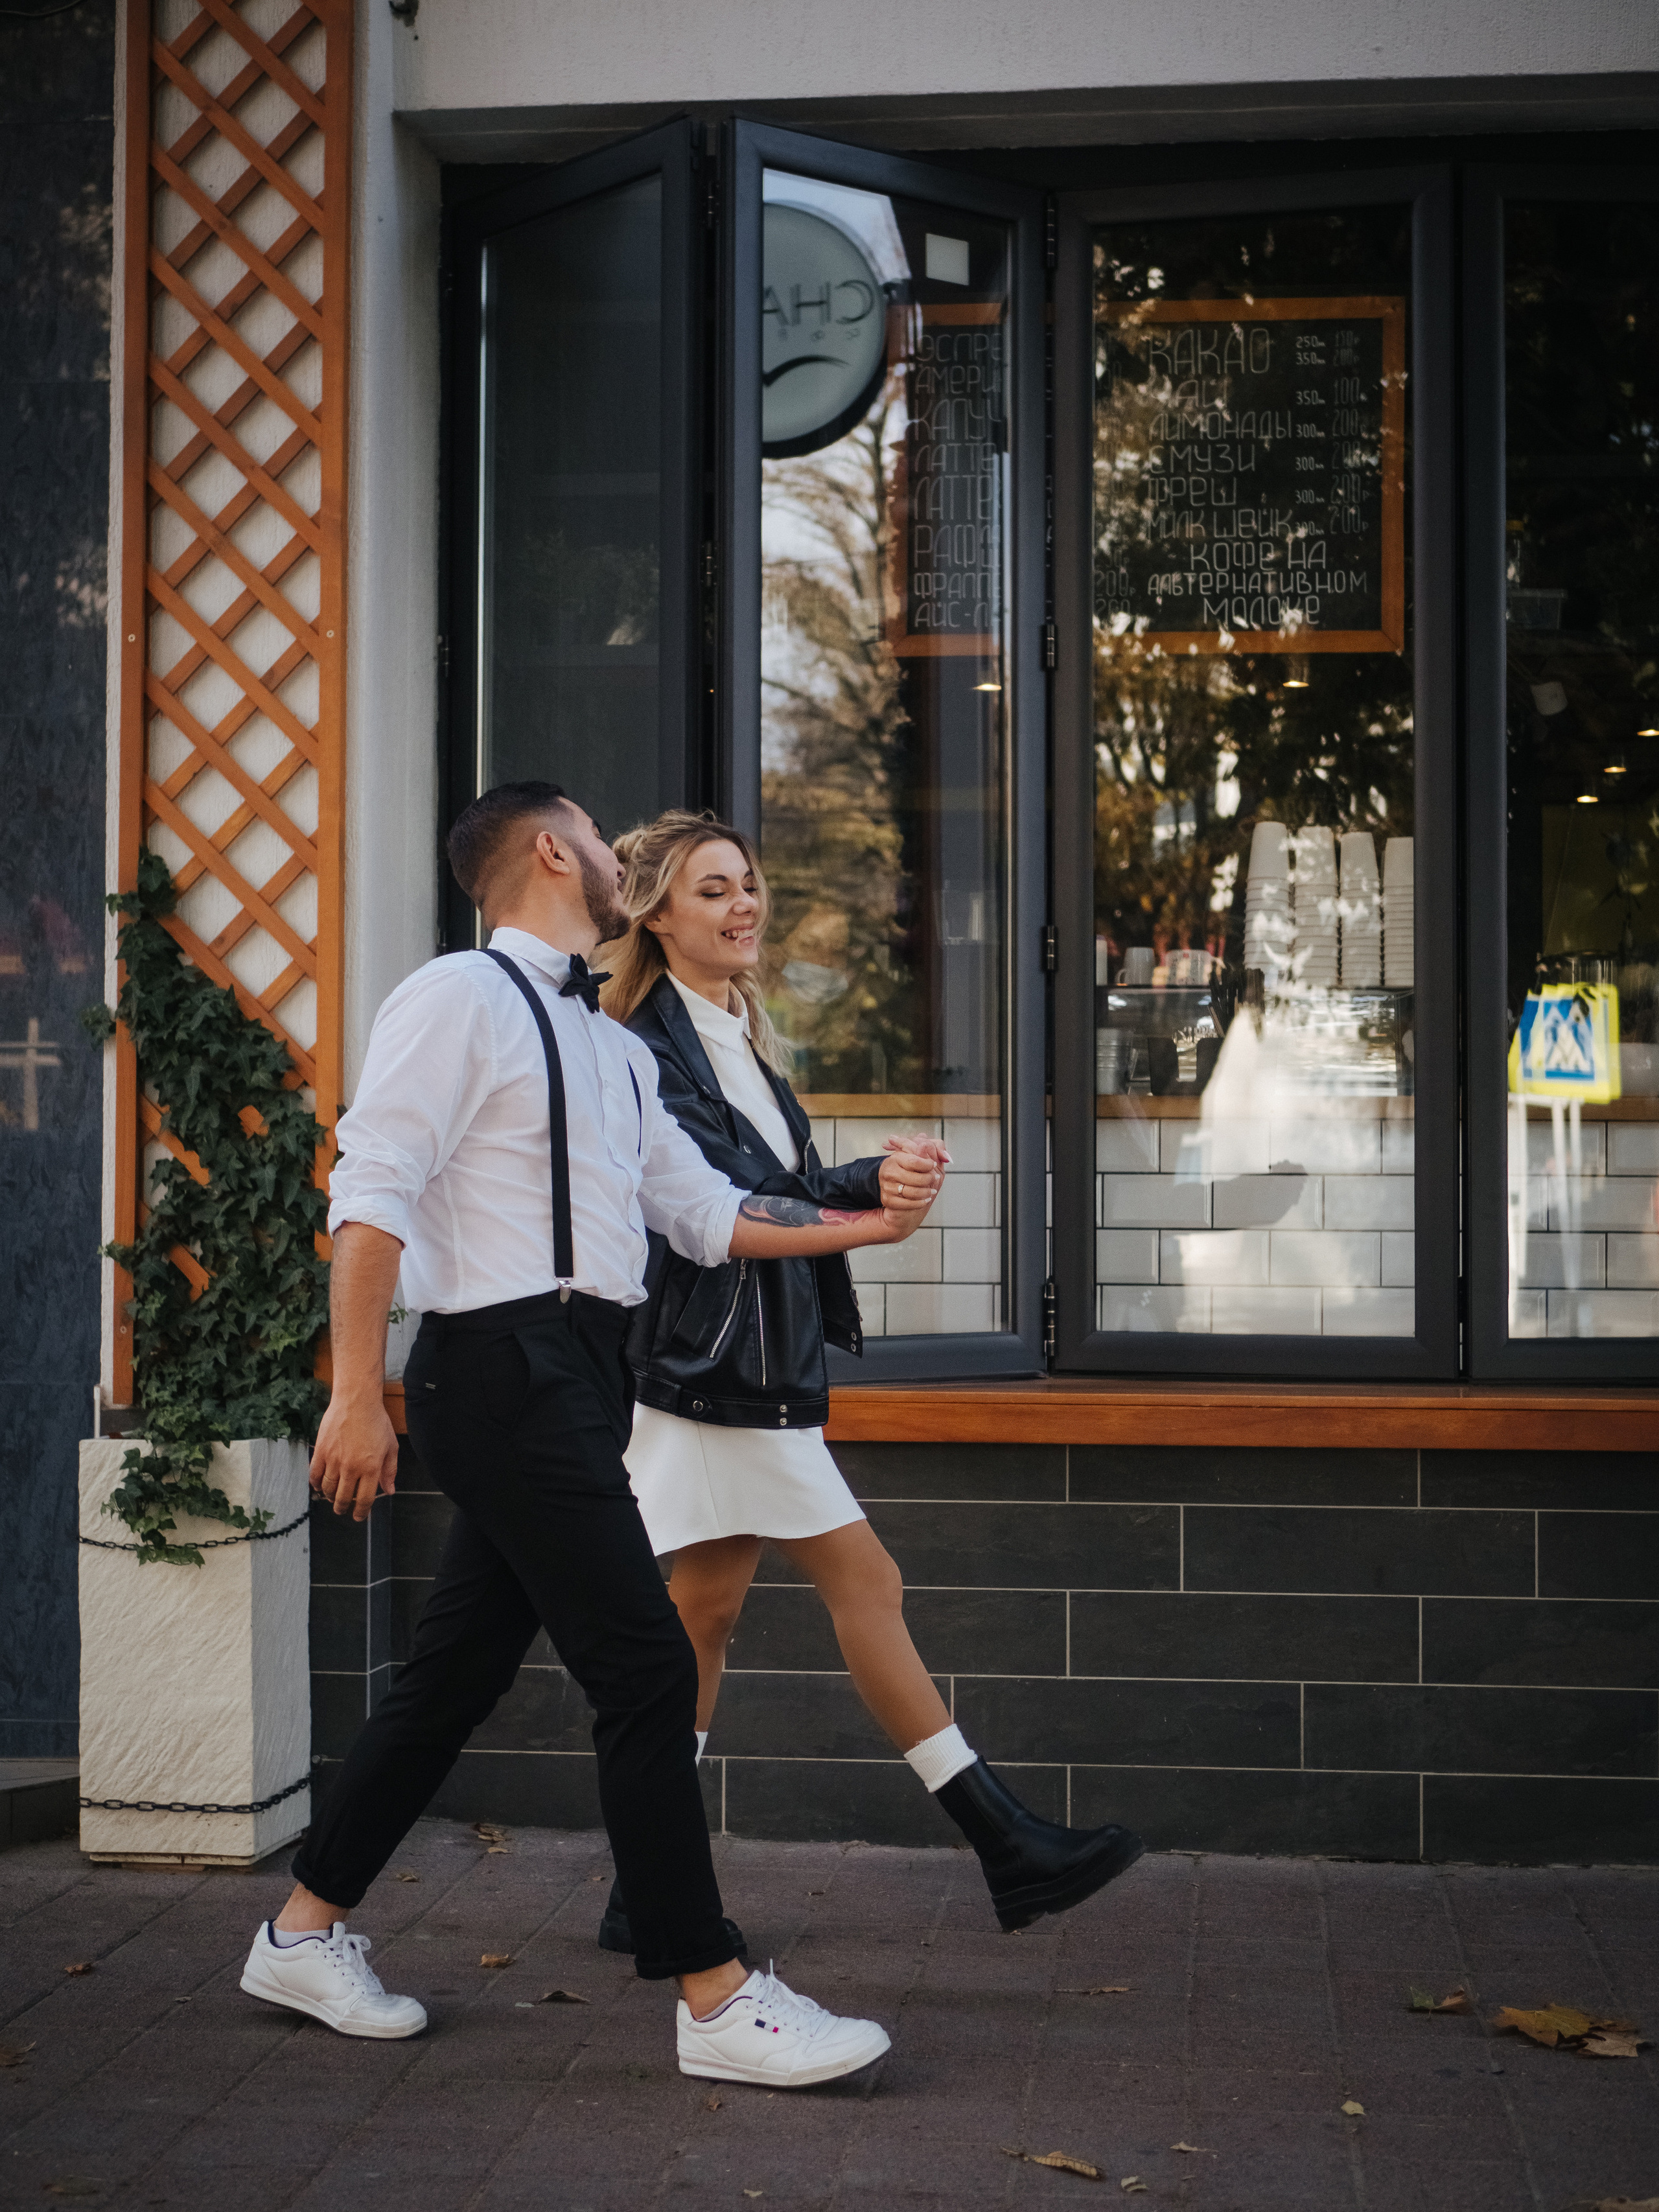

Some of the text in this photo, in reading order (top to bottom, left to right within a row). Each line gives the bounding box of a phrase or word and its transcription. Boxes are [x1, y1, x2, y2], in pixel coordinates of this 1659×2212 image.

[1150, 329, 1270, 375] КАКАО
[915, 365, 1001, 394] АМЕРИ
[1150, 378, 1228, 408] АЙ
[1149, 411, 1292, 441] ЛИМОНАДЫ
[1149, 444, 1255, 474] СМУЗИ
[1148, 477, 1237, 506] ФРЕШ
[914, 524, 976, 568] РАФ
[1190, 541, 1326, 571] КОФЕ НА
